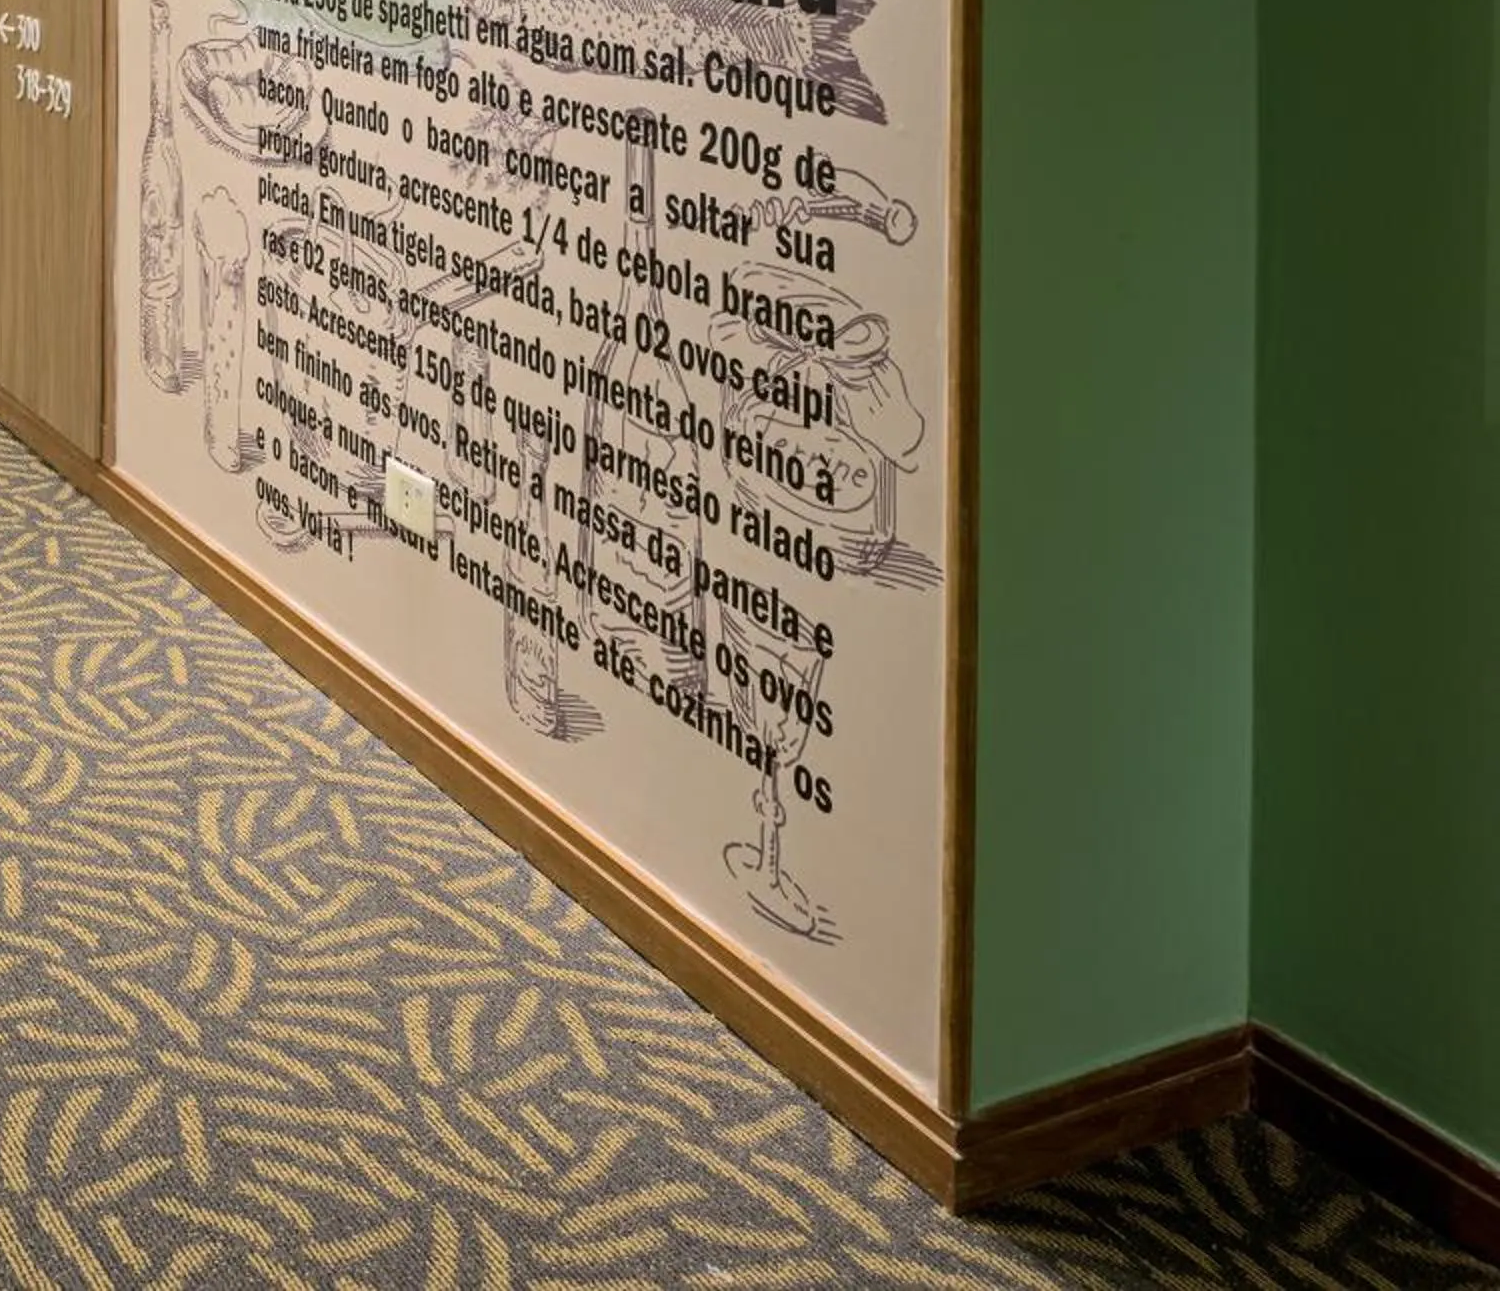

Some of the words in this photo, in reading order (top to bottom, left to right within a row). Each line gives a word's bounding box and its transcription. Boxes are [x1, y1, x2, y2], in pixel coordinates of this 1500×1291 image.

[258, 25, 290, 55] uma
[381, 55, 408, 85] em
[415, 56, 459, 103] fogo
[468, 70, 510, 111] alto
[519, 88, 532, 116] e
[542, 94, 688, 156] acrescente
[700, 122, 783, 191] 200g
[795, 145, 836, 194] de
[322, 87, 388, 136] Quando
[402, 117, 413, 143] o
[428, 117, 490, 167] bacon
[506, 148, 611, 206] começar
[630, 182, 645, 214] a
[665, 192, 752, 246] soltar
[775, 225, 835, 273] sua
[476, 18, 509, 49] em
[517, 15, 573, 68] água
[582, 37, 635, 75] com
[644, 45, 693, 87] sal.
[704, 51, 835, 118] Coloque
[258, 123, 313, 164] própria
[319, 145, 392, 202] gordura,
[400, 172, 512, 236] acrescente
[522, 207, 568, 255] 1/4
[577, 226, 608, 270] de
[617, 246, 710, 307] cebola
[722, 271, 835, 351] branca
[319, 192, 345, 232] Em
[350, 211, 387, 248] uma
[393, 220, 447, 271] tigela
[451, 250, 563, 326] separada,
[570, 286, 627, 345] bata
[635, 312, 670, 361] 02
[679, 338, 745, 392] ovos
[752, 366, 834, 428] caipi
[257, 276, 304, 319] gosto.
[308, 295, 407, 371] Acrescente
[415, 344, 465, 406] 150g
[471, 374, 497, 414] de
[503, 395, 577, 456] queijo
[584, 432, 720, 525] parmesão
[731, 502, 835, 582] ralado
[263, 228, 287, 258] ras
[289, 239, 299, 263] e
[303, 238, 325, 277] 02
[400, 287, 556, 379] acrescentando
[564, 356, 672, 432] pimenta
[679, 403, 715, 451] do
[724, 426, 805, 491] reino
[816, 453, 835, 506] à
[256, 476, 294, 522] ovos.
[256, 376, 333, 442] coloque-a
[338, 424, 376, 468] num
[556, 542, 707, 661] Acrescente
[715, 642, 750, 688] os
[760, 668, 833, 738] ovos
[257, 319, 289, 363] bem
[295, 339, 351, 397] fininho
[359, 382, 391, 418] aos
[400, 402, 447, 450] ovos.
[456, 423, 520, 489] Retire
[531, 472, 543, 502] a
[554, 482, 636, 552] massa
[648, 527, 681, 577] da
[693, 558, 800, 642] panela
[814, 622, 835, 659] e
[256, 427, 265, 450] e
[273, 436, 281, 460] o
[289, 440, 339, 498] bacon
[347, 485, 357, 509] e
[450, 538, 580, 651] lentamente
[649, 673, 778, 776] cozinhar
[793, 765, 833, 814] os
